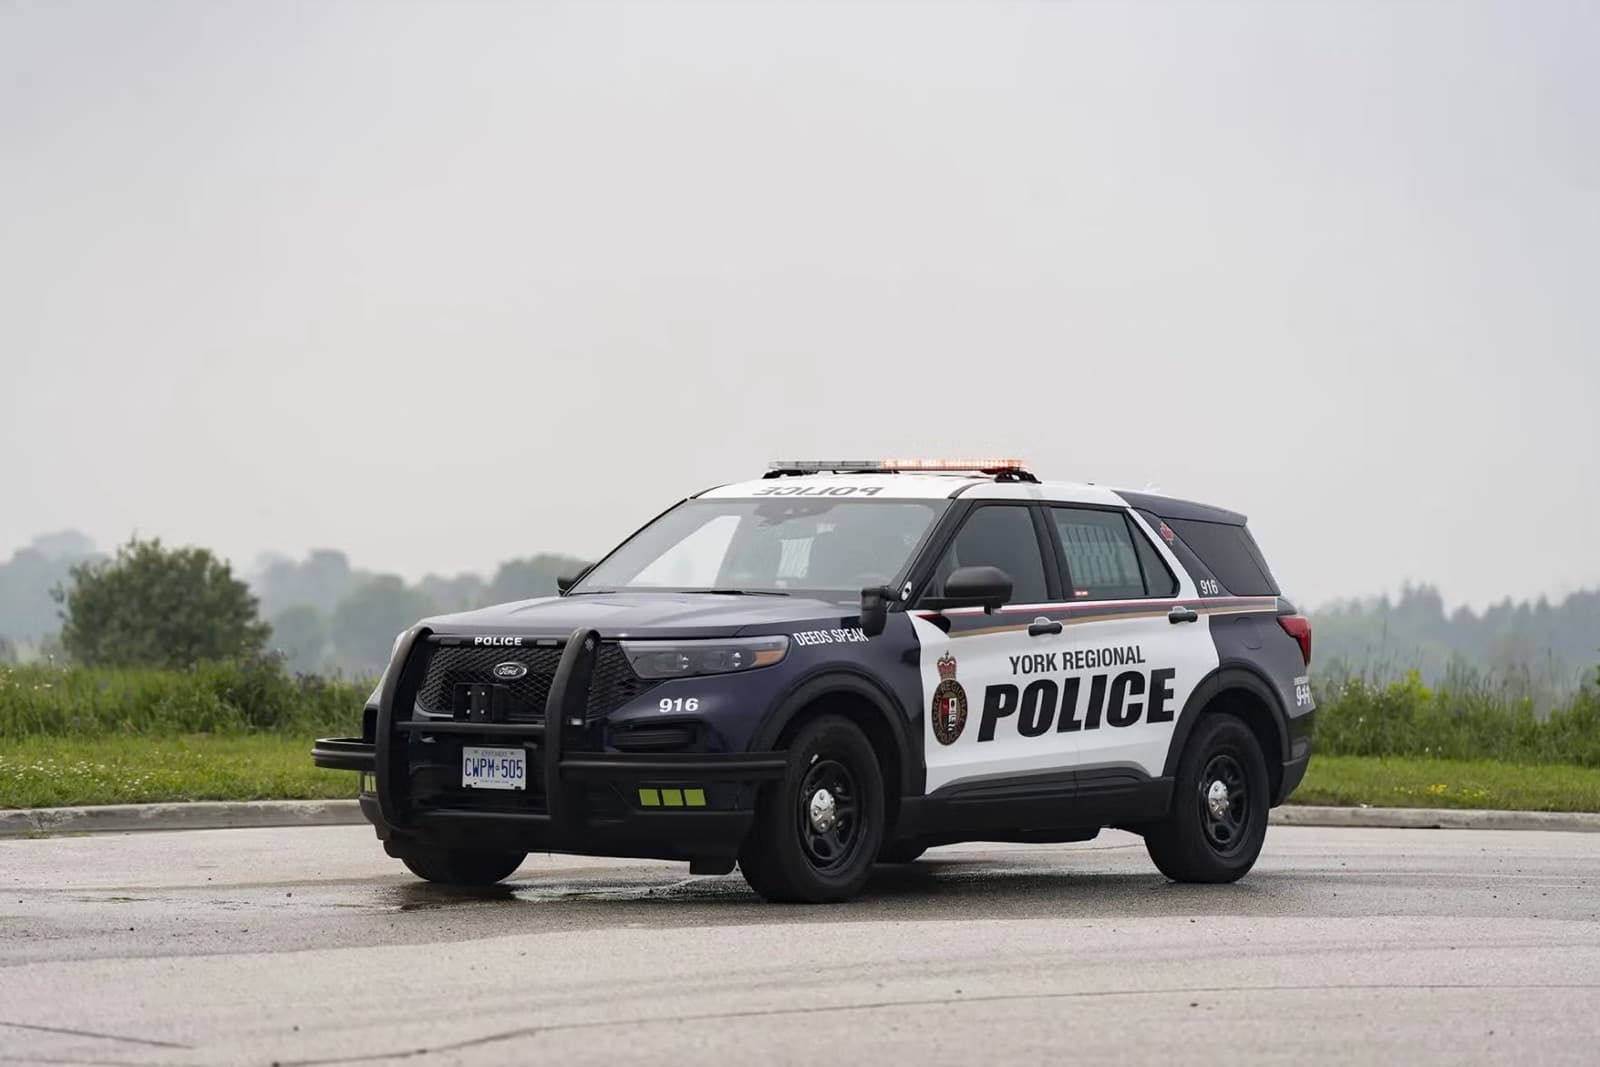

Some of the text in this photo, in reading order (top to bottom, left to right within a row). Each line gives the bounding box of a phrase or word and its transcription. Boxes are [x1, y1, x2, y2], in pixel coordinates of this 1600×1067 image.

[1200, 579, 1219, 595] 916
[474, 636, 523, 646] POLICE
[793, 628, 869, 645] DEEDS SPEAK
[1009, 645, 1146, 675] YORK REGIONAL
[659, 697, 699, 713] 916
[977, 667, 1176, 743] POLICE
